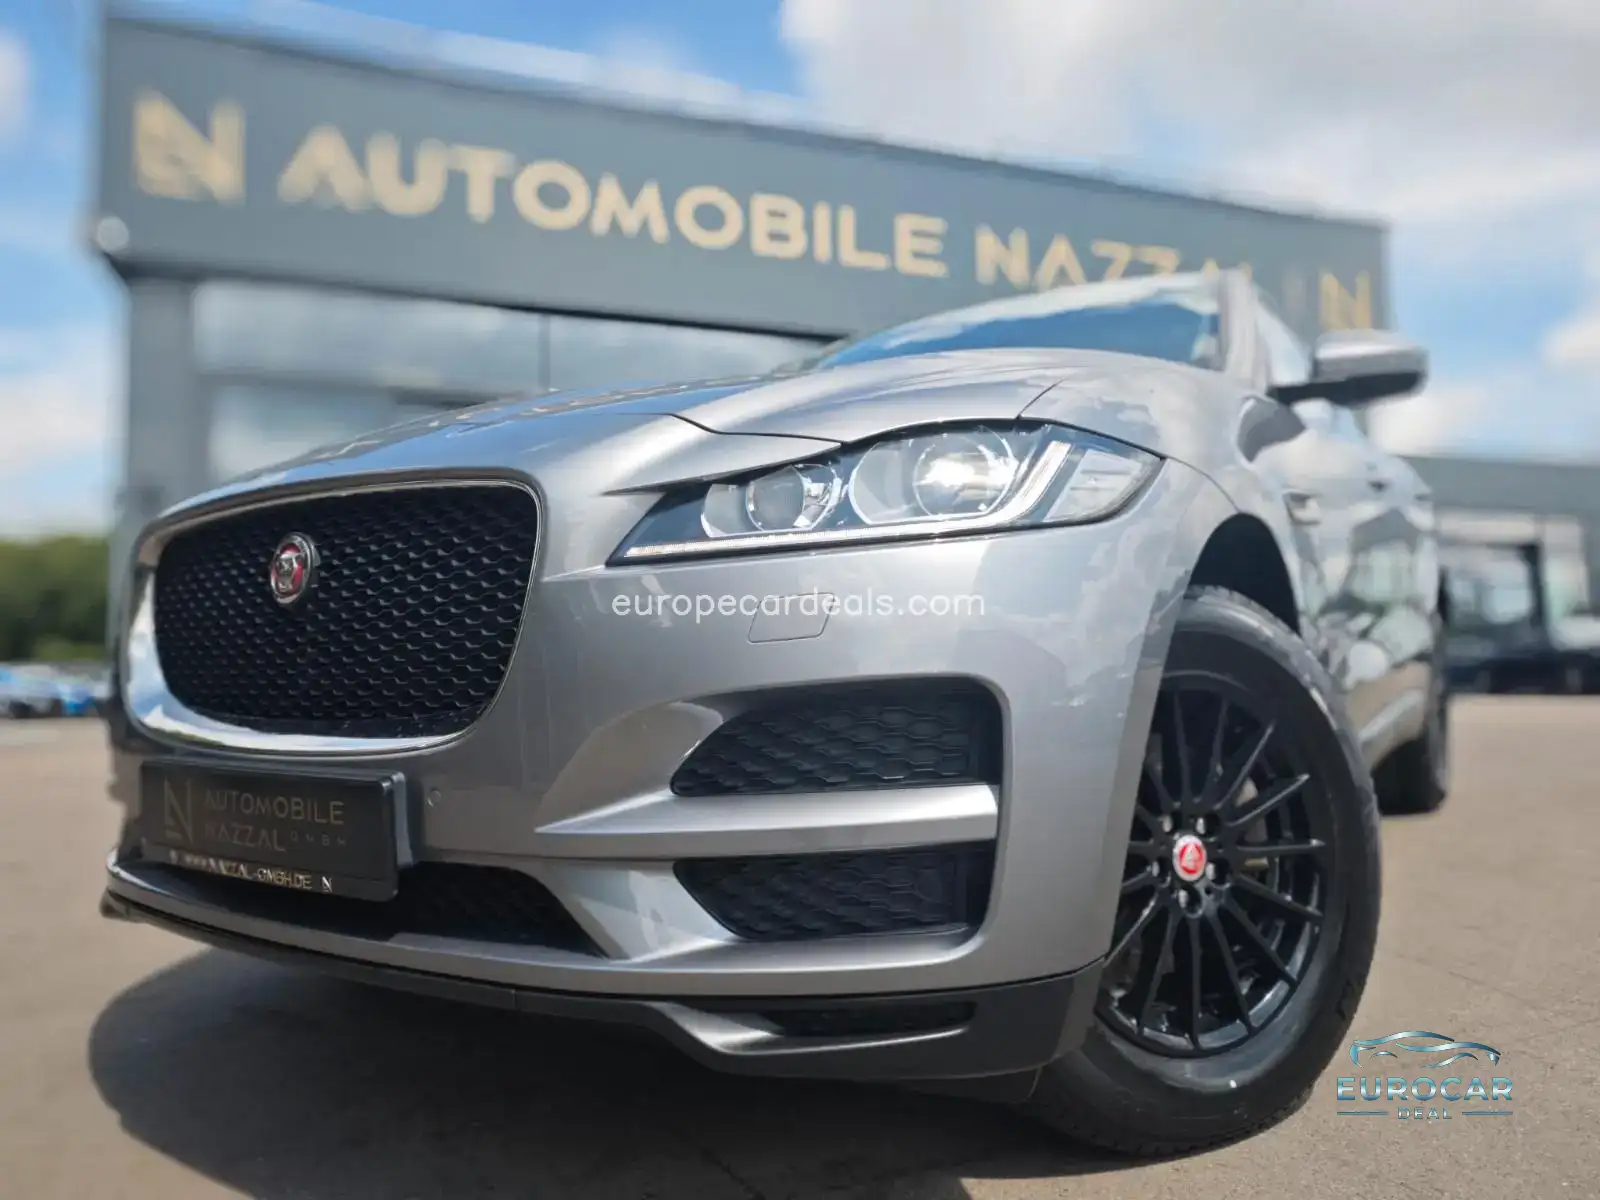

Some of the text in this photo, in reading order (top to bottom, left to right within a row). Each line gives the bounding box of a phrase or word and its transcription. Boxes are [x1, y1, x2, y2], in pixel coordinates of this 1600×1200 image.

[279, 124, 948, 278] AUTOMOBILE
[975, 224, 1253, 293] NAZZ
[204, 789, 345, 825] AUTOMOBILE
[204, 822, 287, 852] NAZZAL
